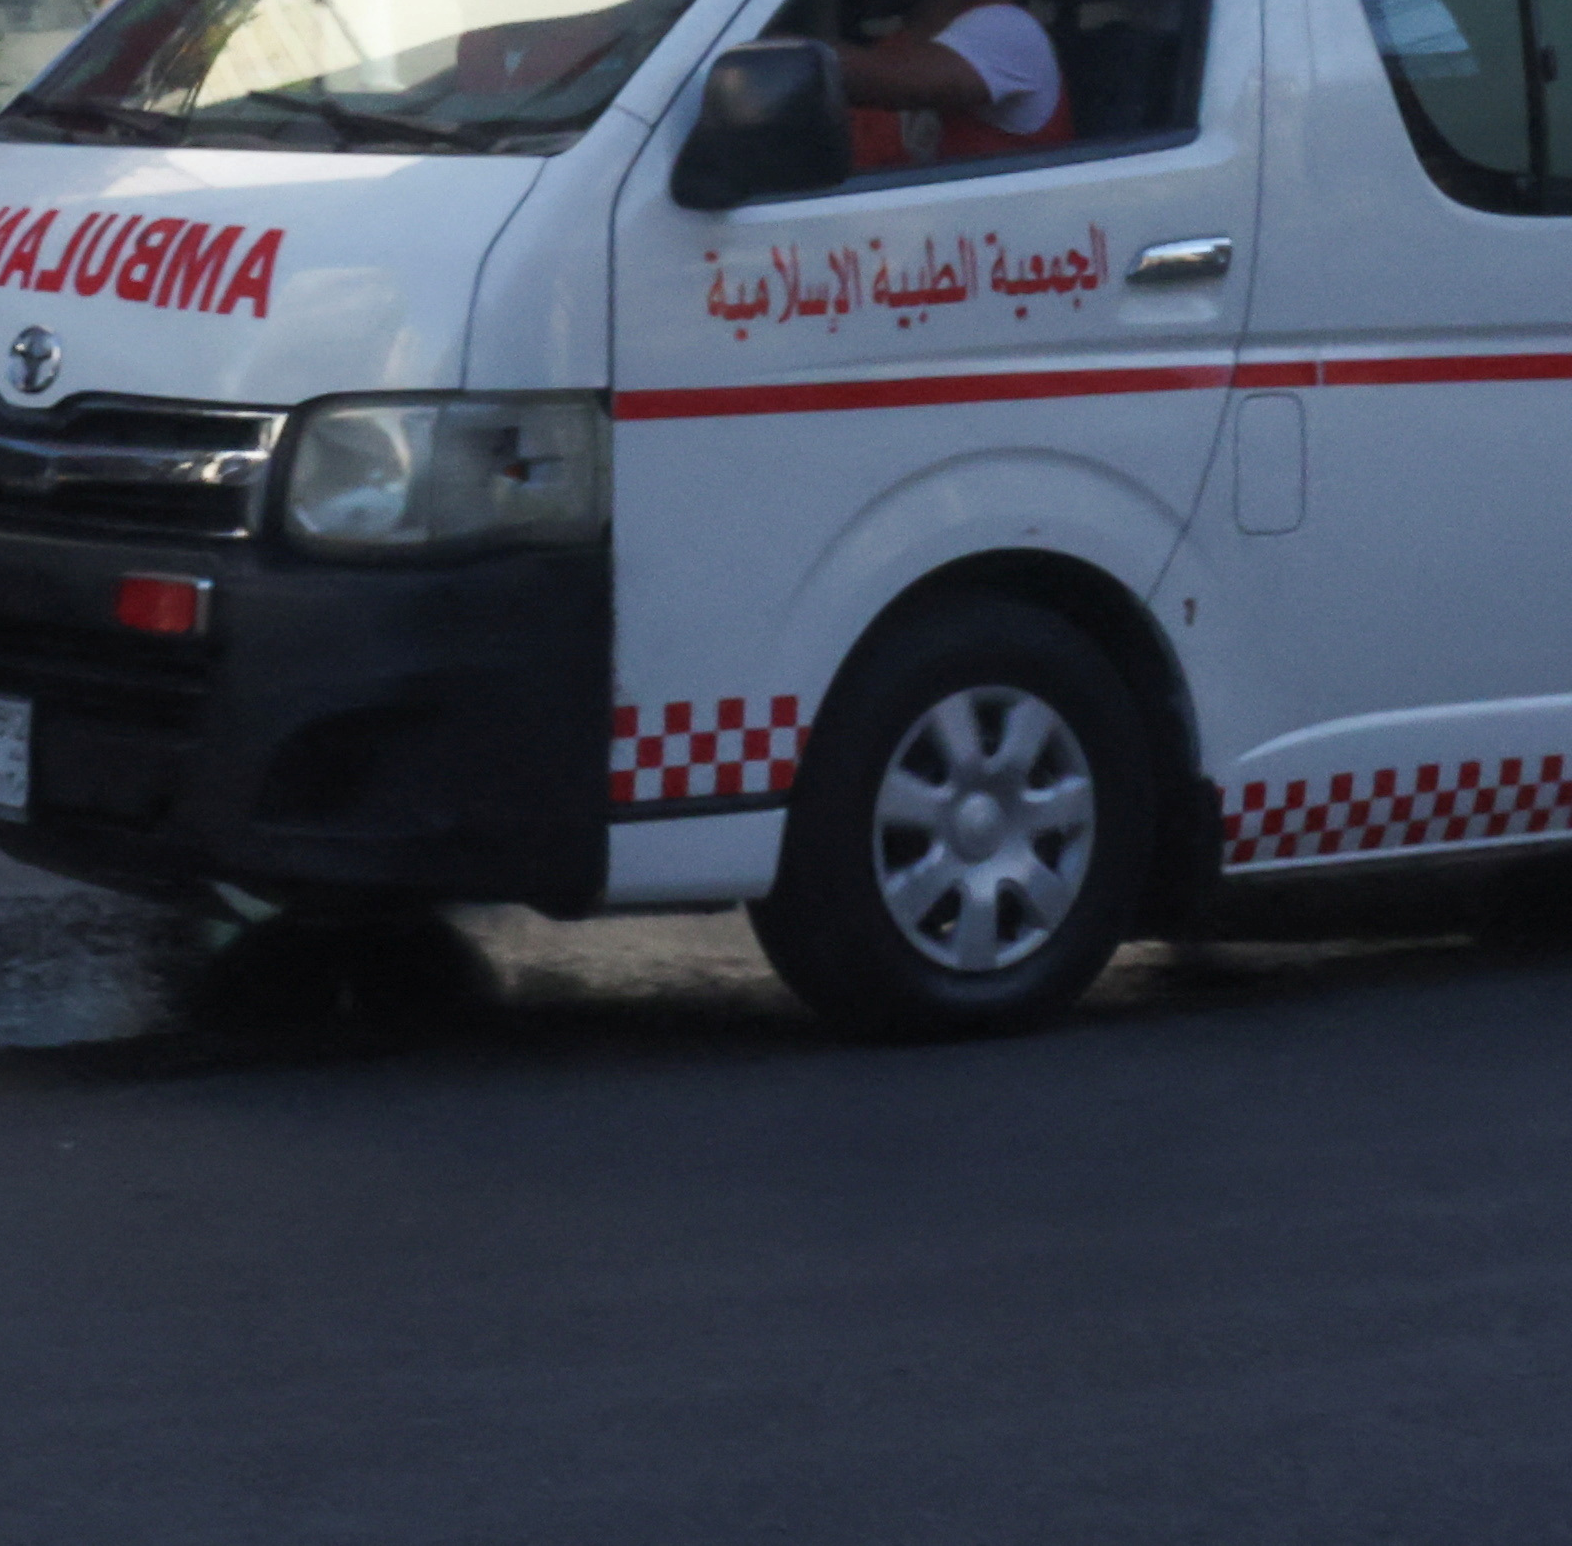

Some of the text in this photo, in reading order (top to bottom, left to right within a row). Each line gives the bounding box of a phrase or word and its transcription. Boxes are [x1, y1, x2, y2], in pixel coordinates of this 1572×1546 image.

[704, 221, 1110, 341] الجمعية الطبية الإسلامية
